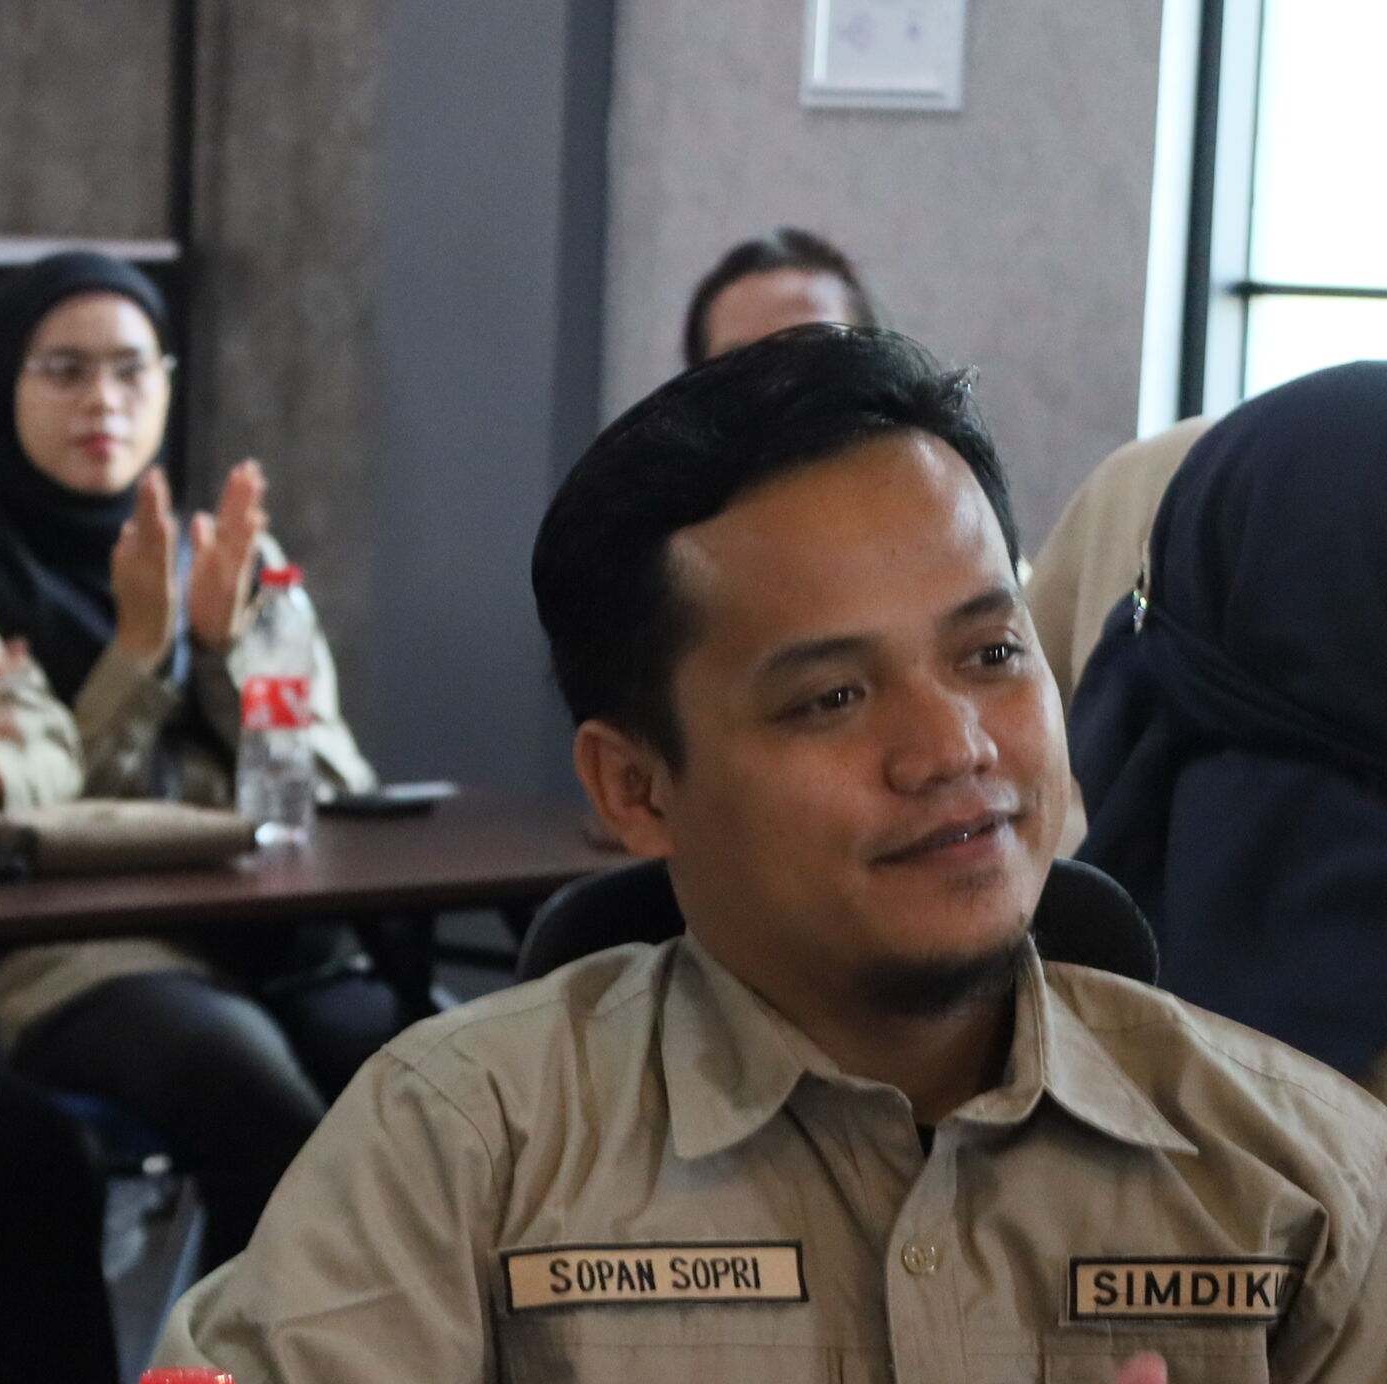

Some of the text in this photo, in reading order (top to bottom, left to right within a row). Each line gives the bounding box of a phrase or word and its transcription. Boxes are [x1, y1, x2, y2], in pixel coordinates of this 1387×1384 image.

[549, 1256, 762, 1294] SOPAN SOPRI
[1093, 1269, 1280, 1308] SIMDIK
